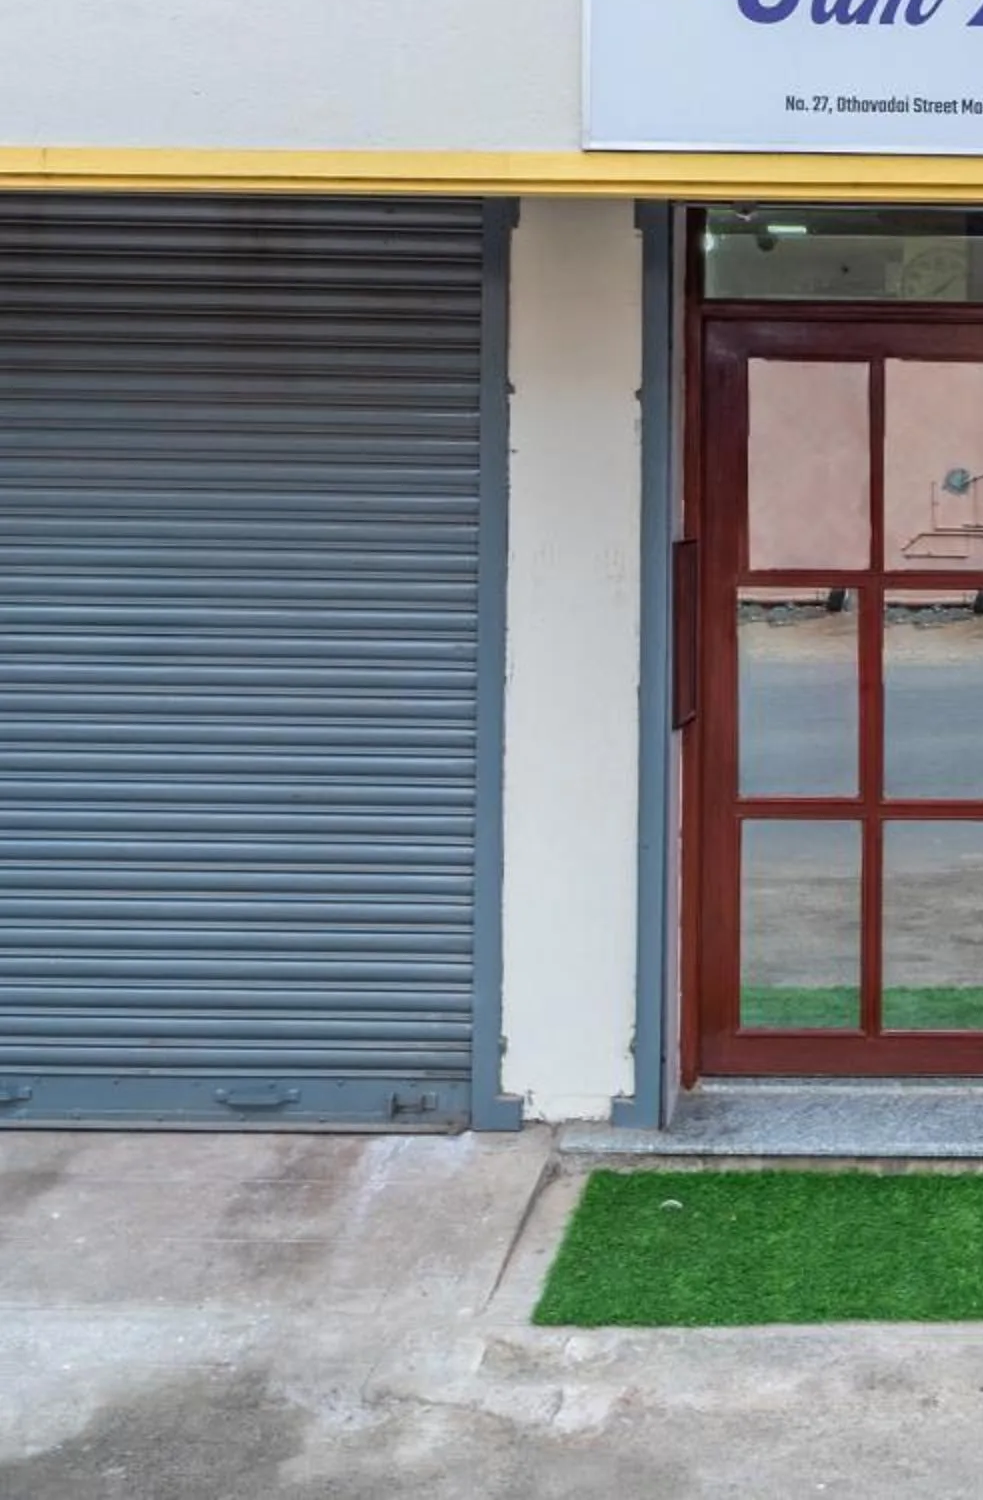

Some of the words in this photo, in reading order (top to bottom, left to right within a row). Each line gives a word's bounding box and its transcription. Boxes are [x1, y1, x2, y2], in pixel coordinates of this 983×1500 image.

[785, 94, 810, 112] No.
[812, 95, 833, 115] 27,
[912, 96, 959, 115] Street
